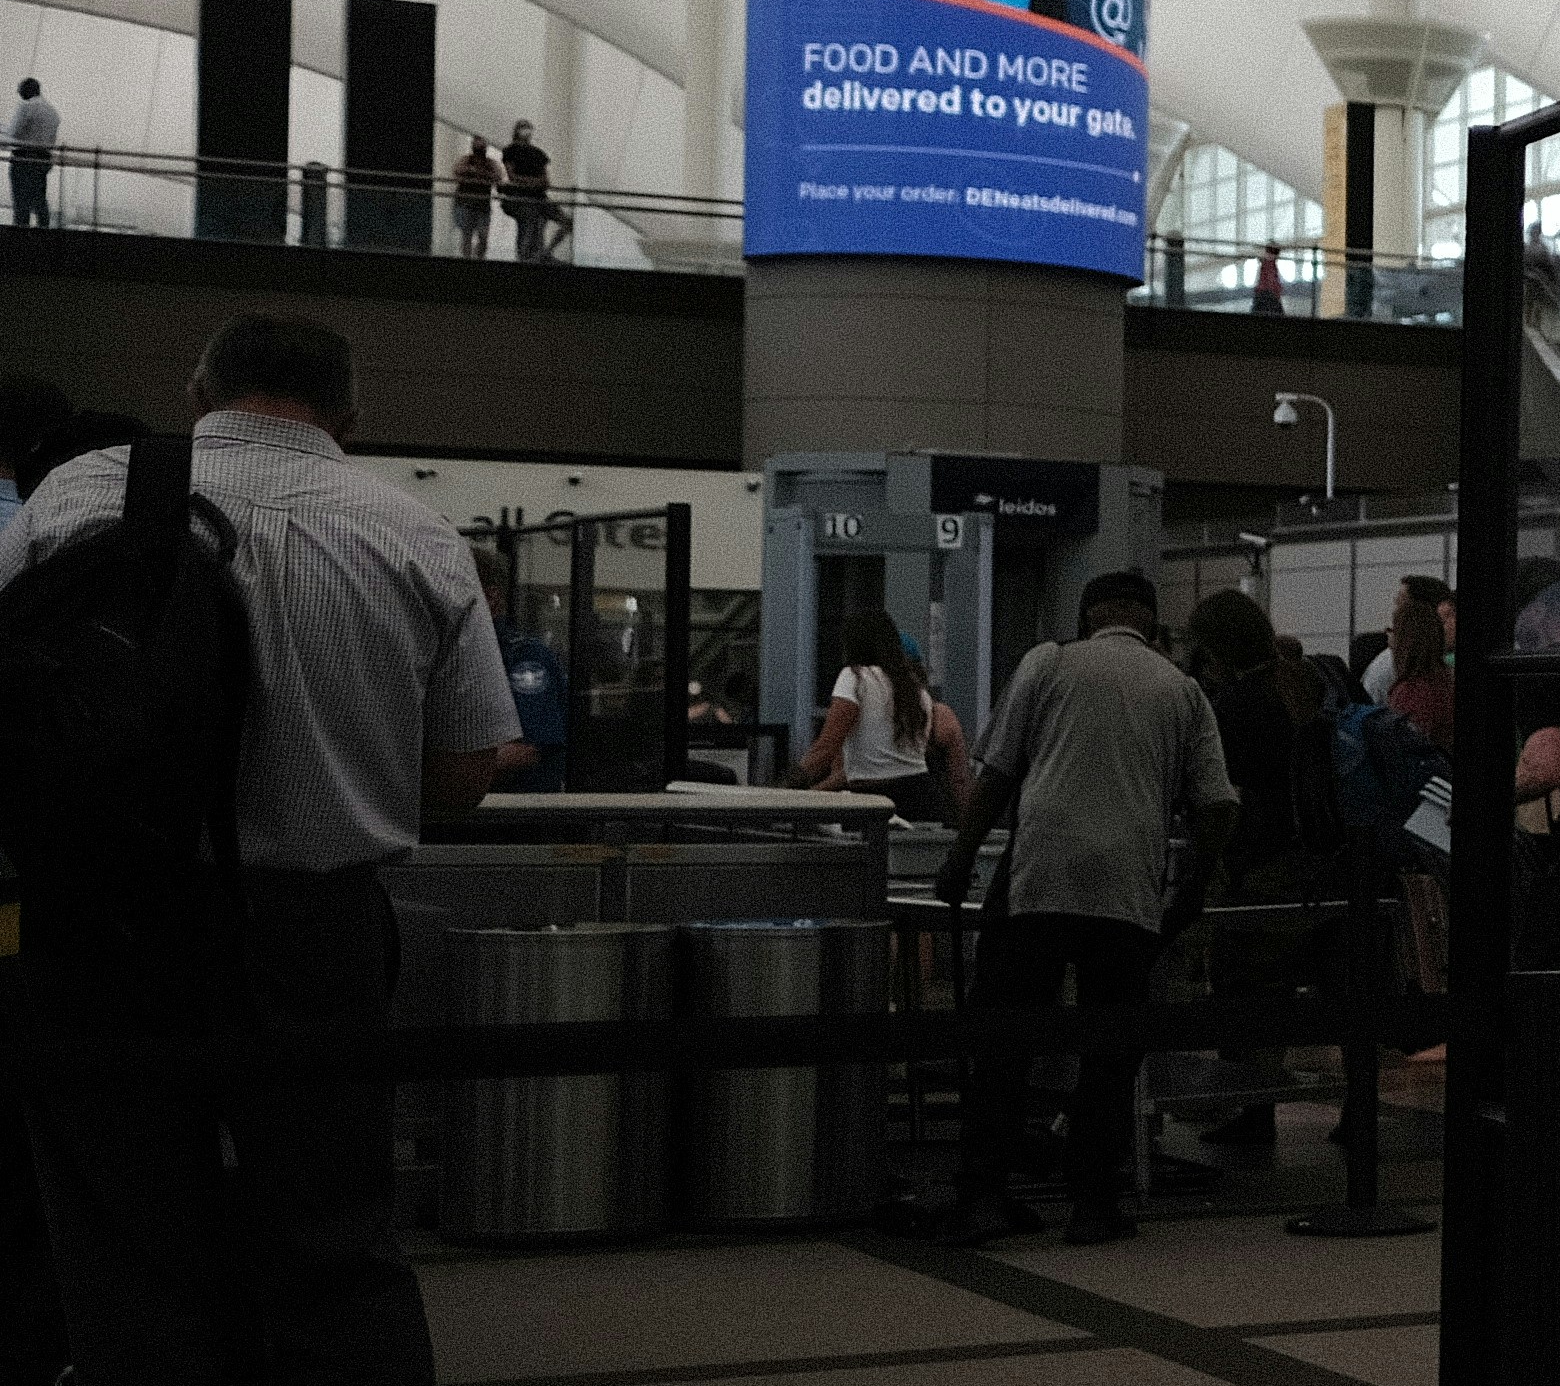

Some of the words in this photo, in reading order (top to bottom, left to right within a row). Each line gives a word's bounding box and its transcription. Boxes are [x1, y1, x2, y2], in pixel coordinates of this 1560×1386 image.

[803, 44, 899, 74] FOOD
[908, 47, 989, 80] AND
[998, 52, 1089, 94] MORE
[802, 80, 962, 115] delivered
[970, 88, 1007, 119] to
[1014, 97, 1082, 128] your
[799, 180, 850, 201] Place
[853, 184, 896, 204] your
[998, 498, 1057, 517] leidos
[825, 514, 863, 540] 10
[941, 517, 960, 544] 9
